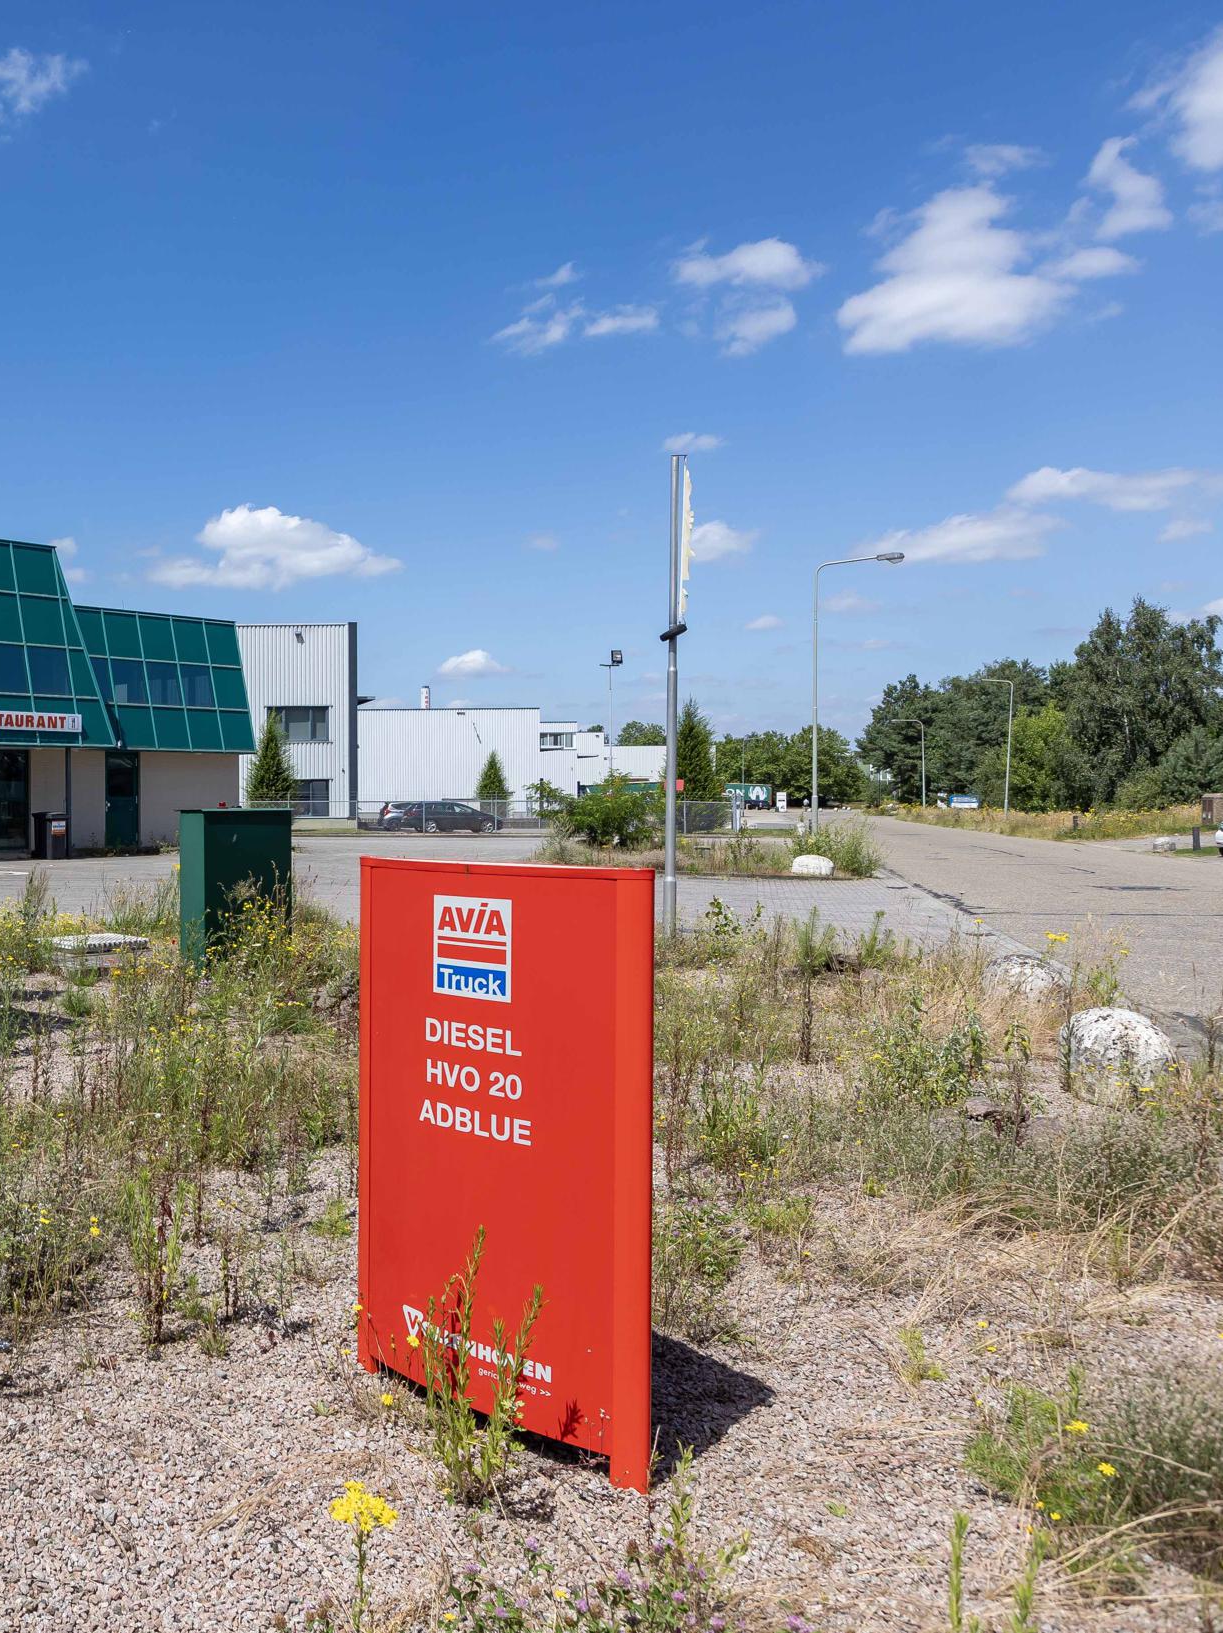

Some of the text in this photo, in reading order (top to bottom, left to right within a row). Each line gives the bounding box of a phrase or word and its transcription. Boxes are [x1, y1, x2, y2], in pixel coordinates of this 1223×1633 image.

[437, 902, 507, 937] AVIA
[439, 967, 503, 997] Truck
[424, 1017, 522, 1057] DIESEL
[425, 1058, 522, 1101] HVO 20
[418, 1099, 532, 1147] ADBLUE
